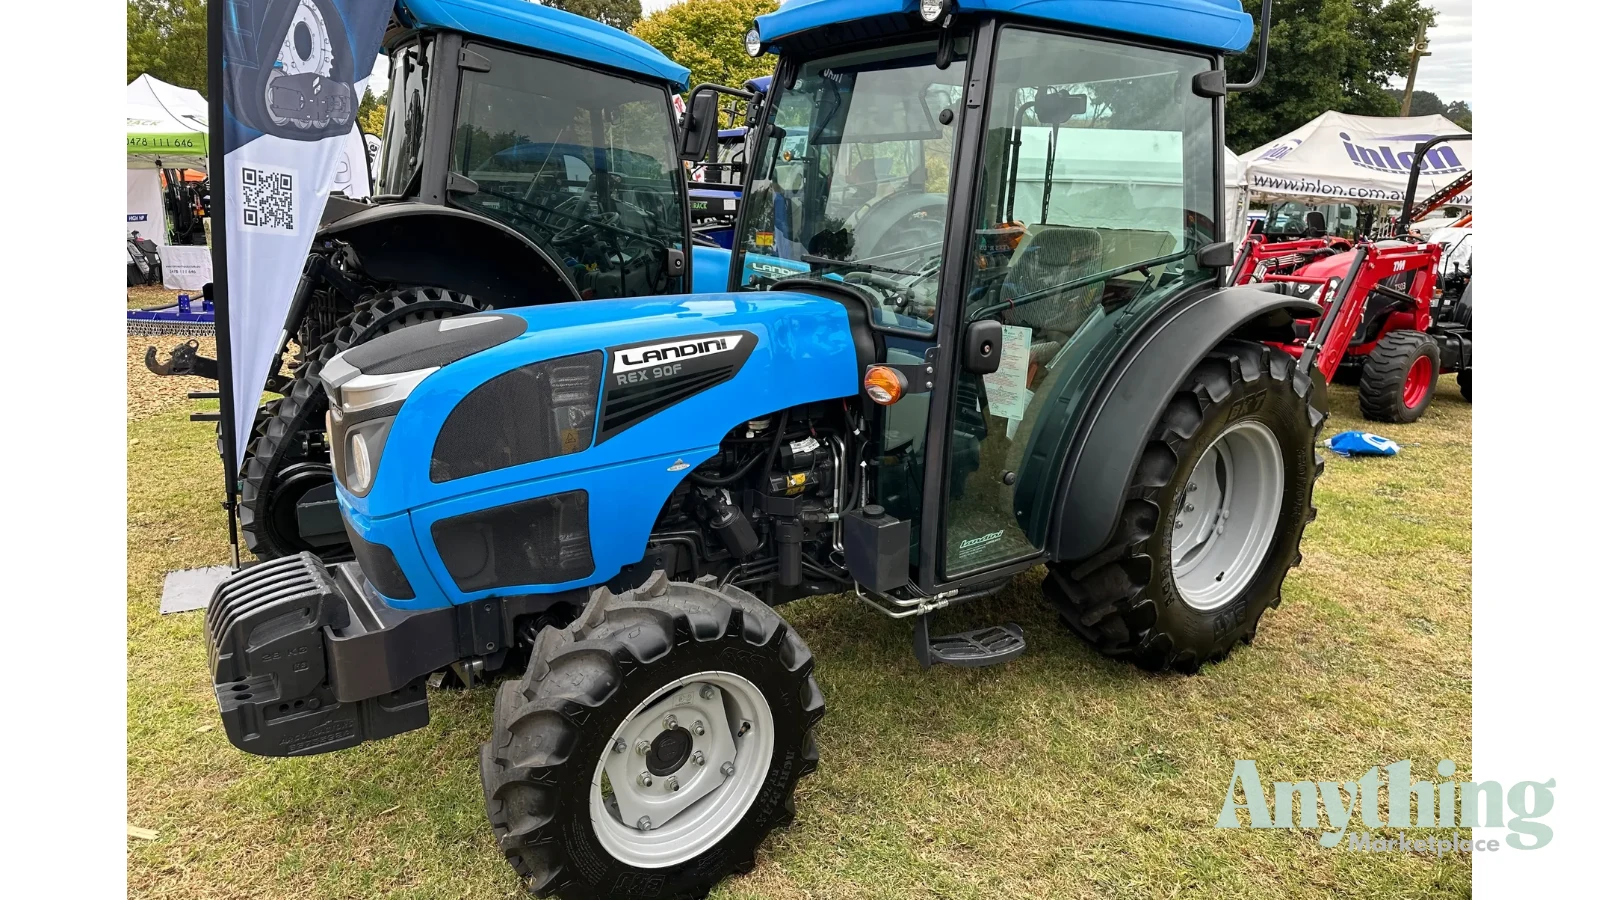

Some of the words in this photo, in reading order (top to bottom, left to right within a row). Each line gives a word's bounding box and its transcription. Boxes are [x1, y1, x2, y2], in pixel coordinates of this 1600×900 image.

[153, 138, 170, 147] 111
[174, 138, 193, 148] 646
[1339, 132, 1462, 171] inlon
[621, 338, 728, 366] LANDINI
[616, 370, 649, 385] REX
[652, 363, 682, 379] 90F
